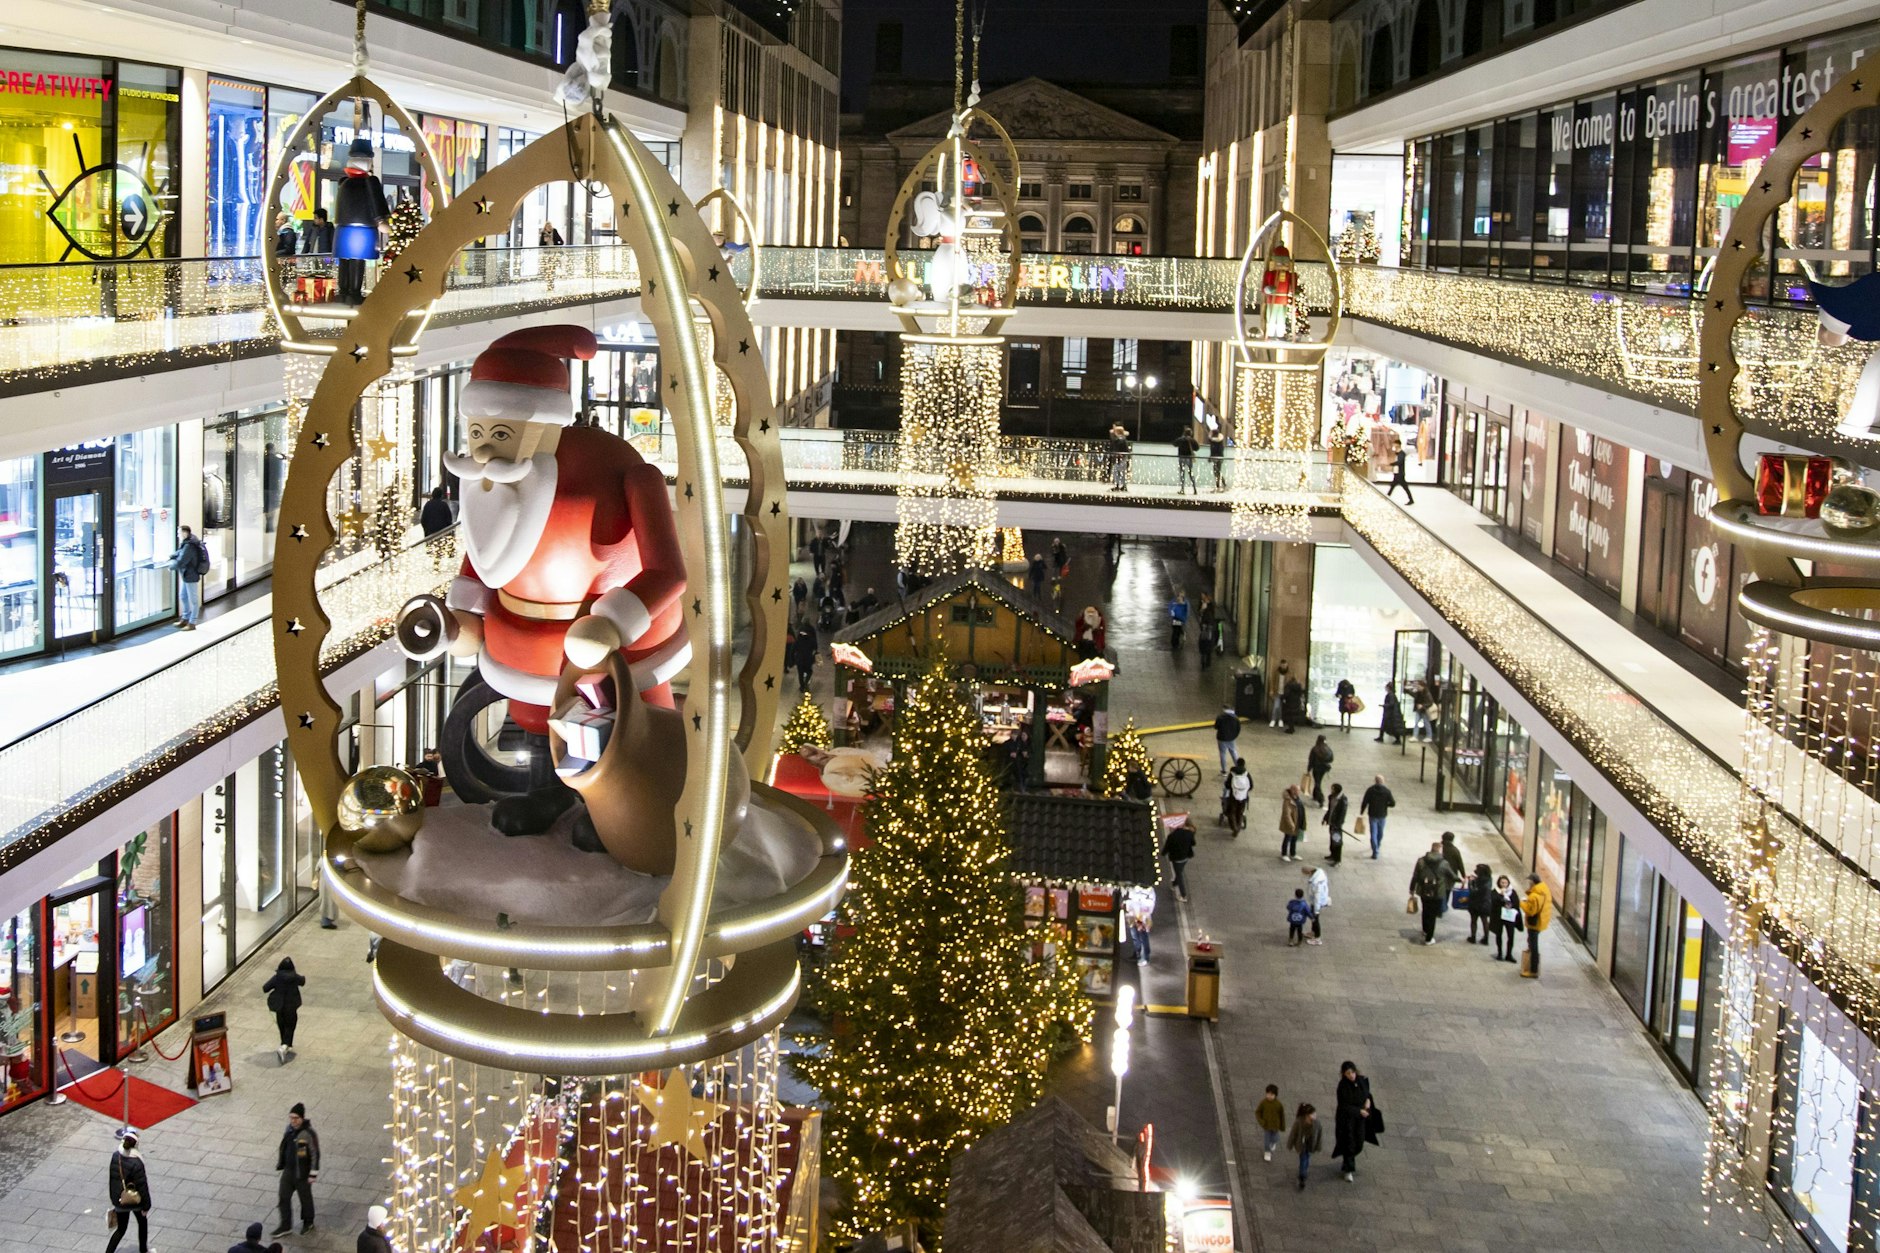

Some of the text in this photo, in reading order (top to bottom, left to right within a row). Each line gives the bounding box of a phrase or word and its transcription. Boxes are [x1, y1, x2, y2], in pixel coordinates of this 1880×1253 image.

[119, 87, 179, 102] STUDIO OF WONDERS
[1551, 109, 1612, 152] Welcome
[1620, 102, 1635, 142] to
[1646, 79, 1716, 138] Berlin's
[1728, 55, 1834, 137] greatest
[65, 454, 74, 463] of
[75, 451, 107, 461] Diamond
